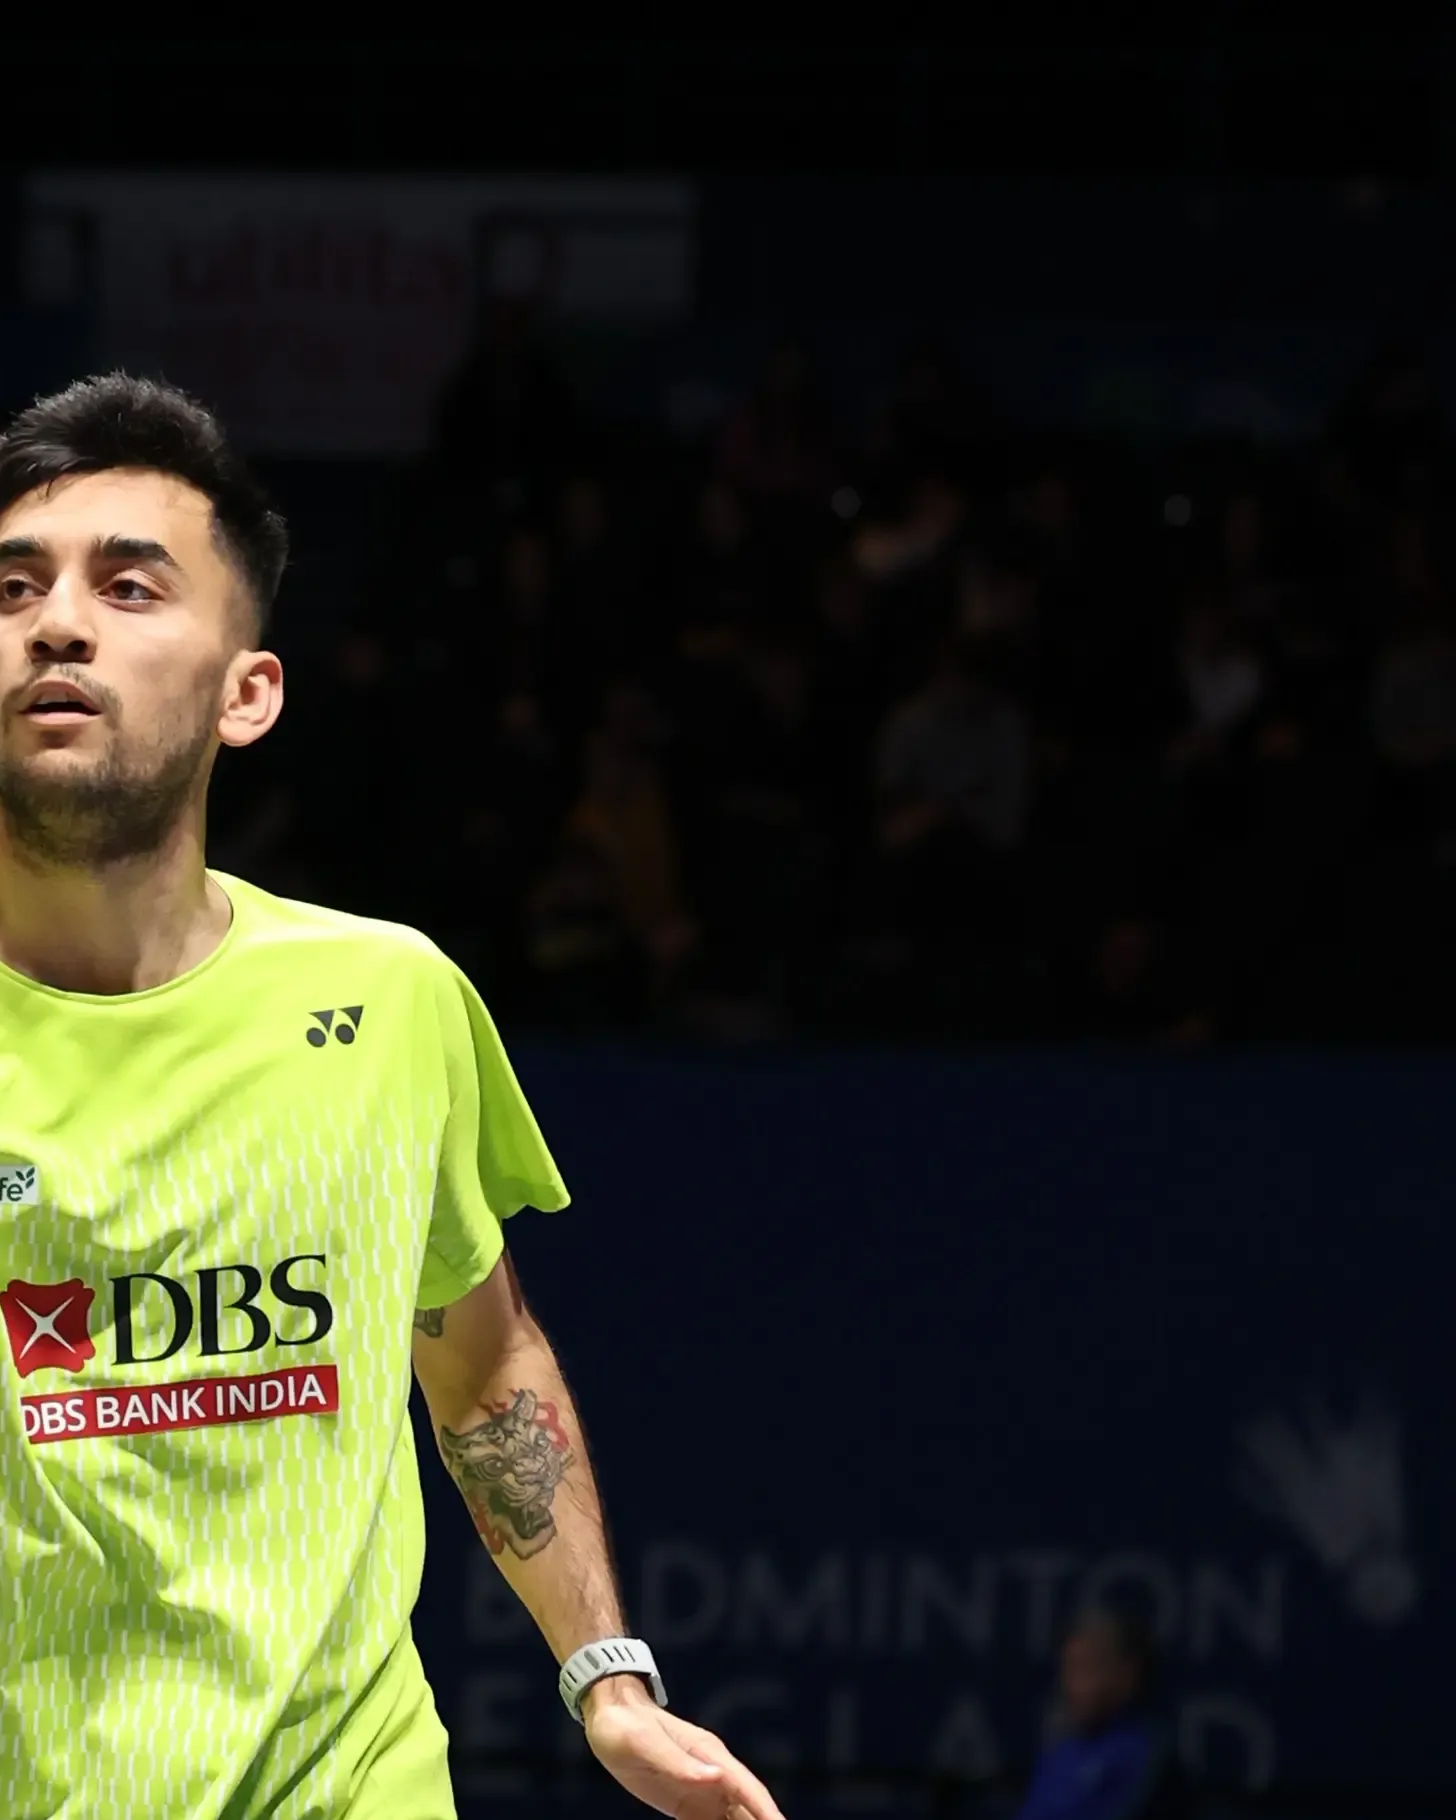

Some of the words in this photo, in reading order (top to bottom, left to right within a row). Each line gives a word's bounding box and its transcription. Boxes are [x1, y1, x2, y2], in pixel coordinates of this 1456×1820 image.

[109, 1253, 334, 1366] DBS
[20, 1397, 87, 1437] DBS
[95, 1386, 206, 1429] BANK
[215, 1373, 327, 1417] INDIA
[464, 1536, 1286, 1661] BDMINTON
